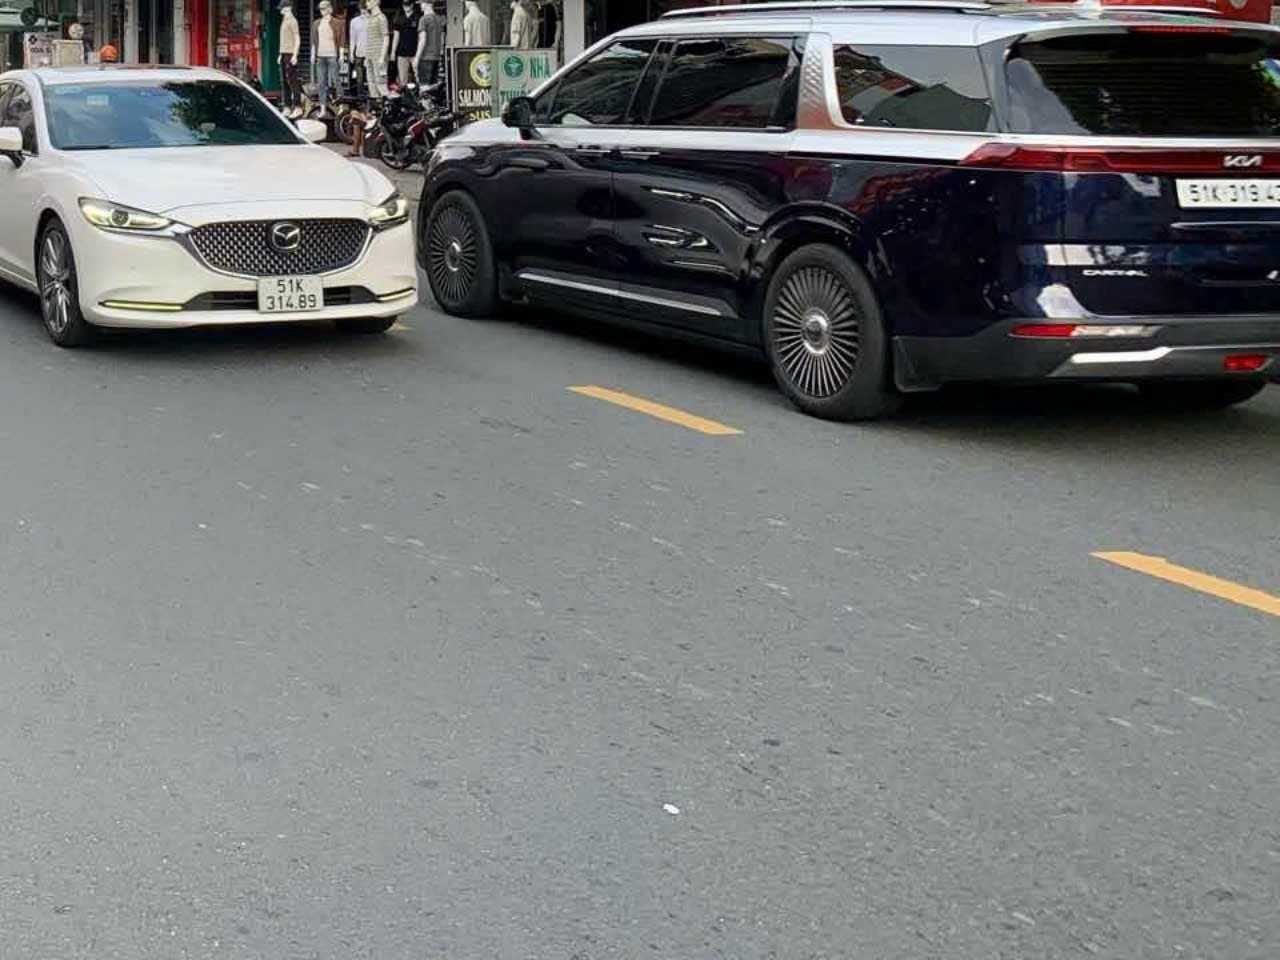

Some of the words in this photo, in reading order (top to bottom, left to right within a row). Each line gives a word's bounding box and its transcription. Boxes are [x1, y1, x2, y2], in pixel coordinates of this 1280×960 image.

[530, 54, 552, 78] NHÀ
[459, 89, 491, 107] SALMON
[1223, 155, 1263, 168] KIA
[277, 279, 304, 293] 51K
[266, 294, 317, 310] 314.89
